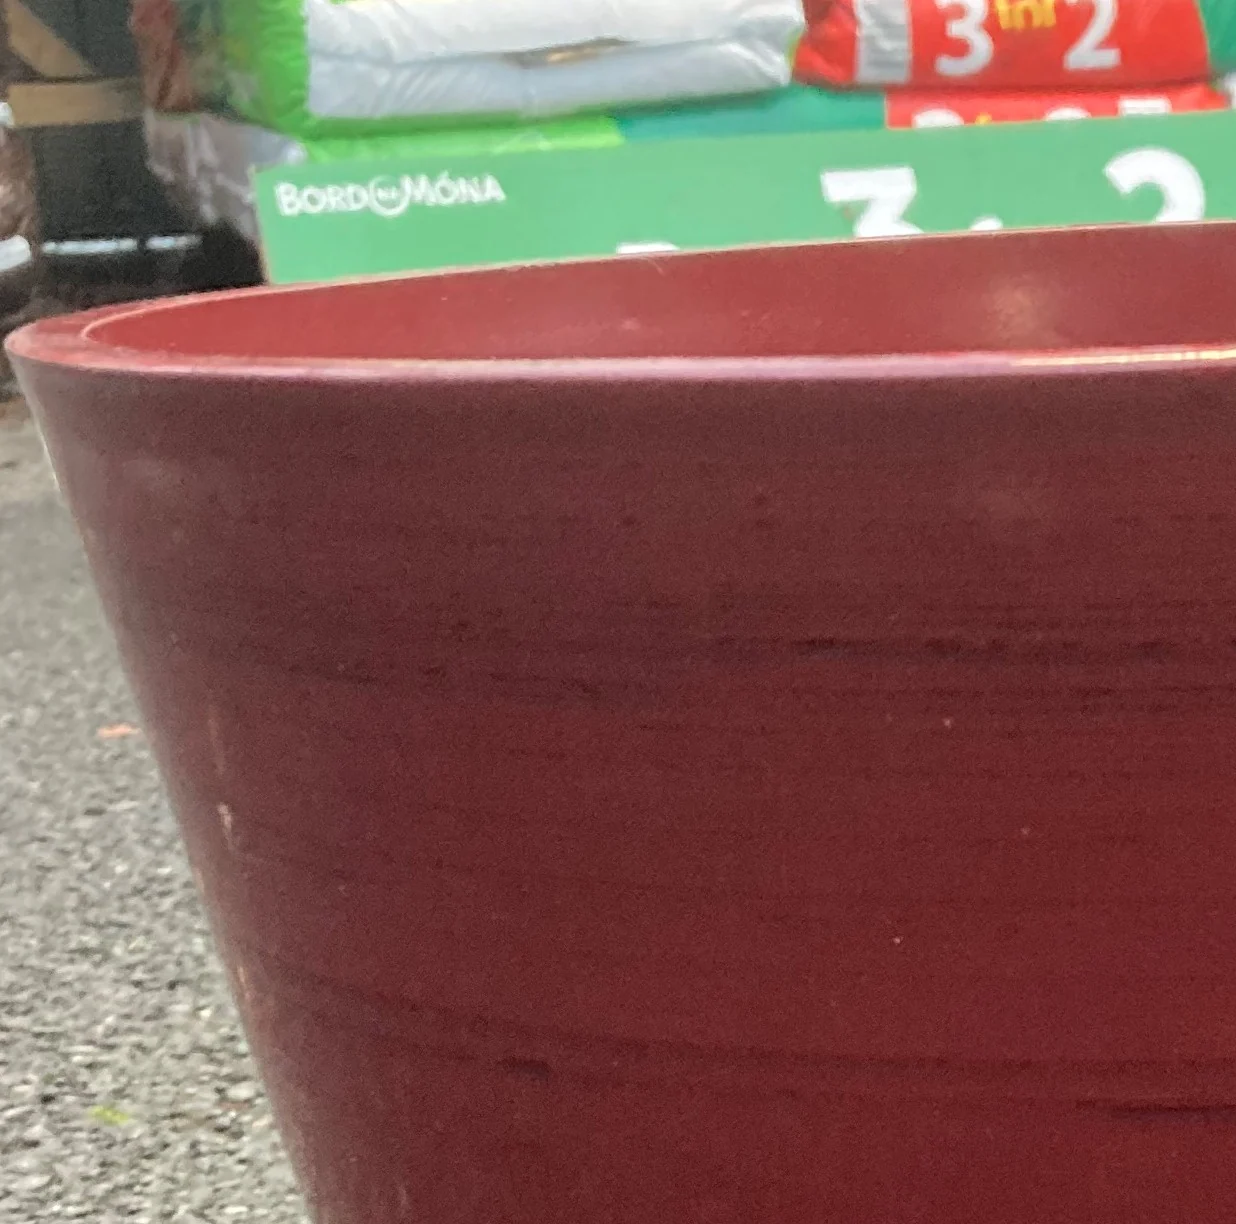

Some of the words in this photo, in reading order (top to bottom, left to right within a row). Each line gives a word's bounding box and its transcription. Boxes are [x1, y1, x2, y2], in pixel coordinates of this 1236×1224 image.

[934, 0, 995, 77] 3
[1063, 0, 1122, 71] 2
[274, 181, 368, 217] BORD
